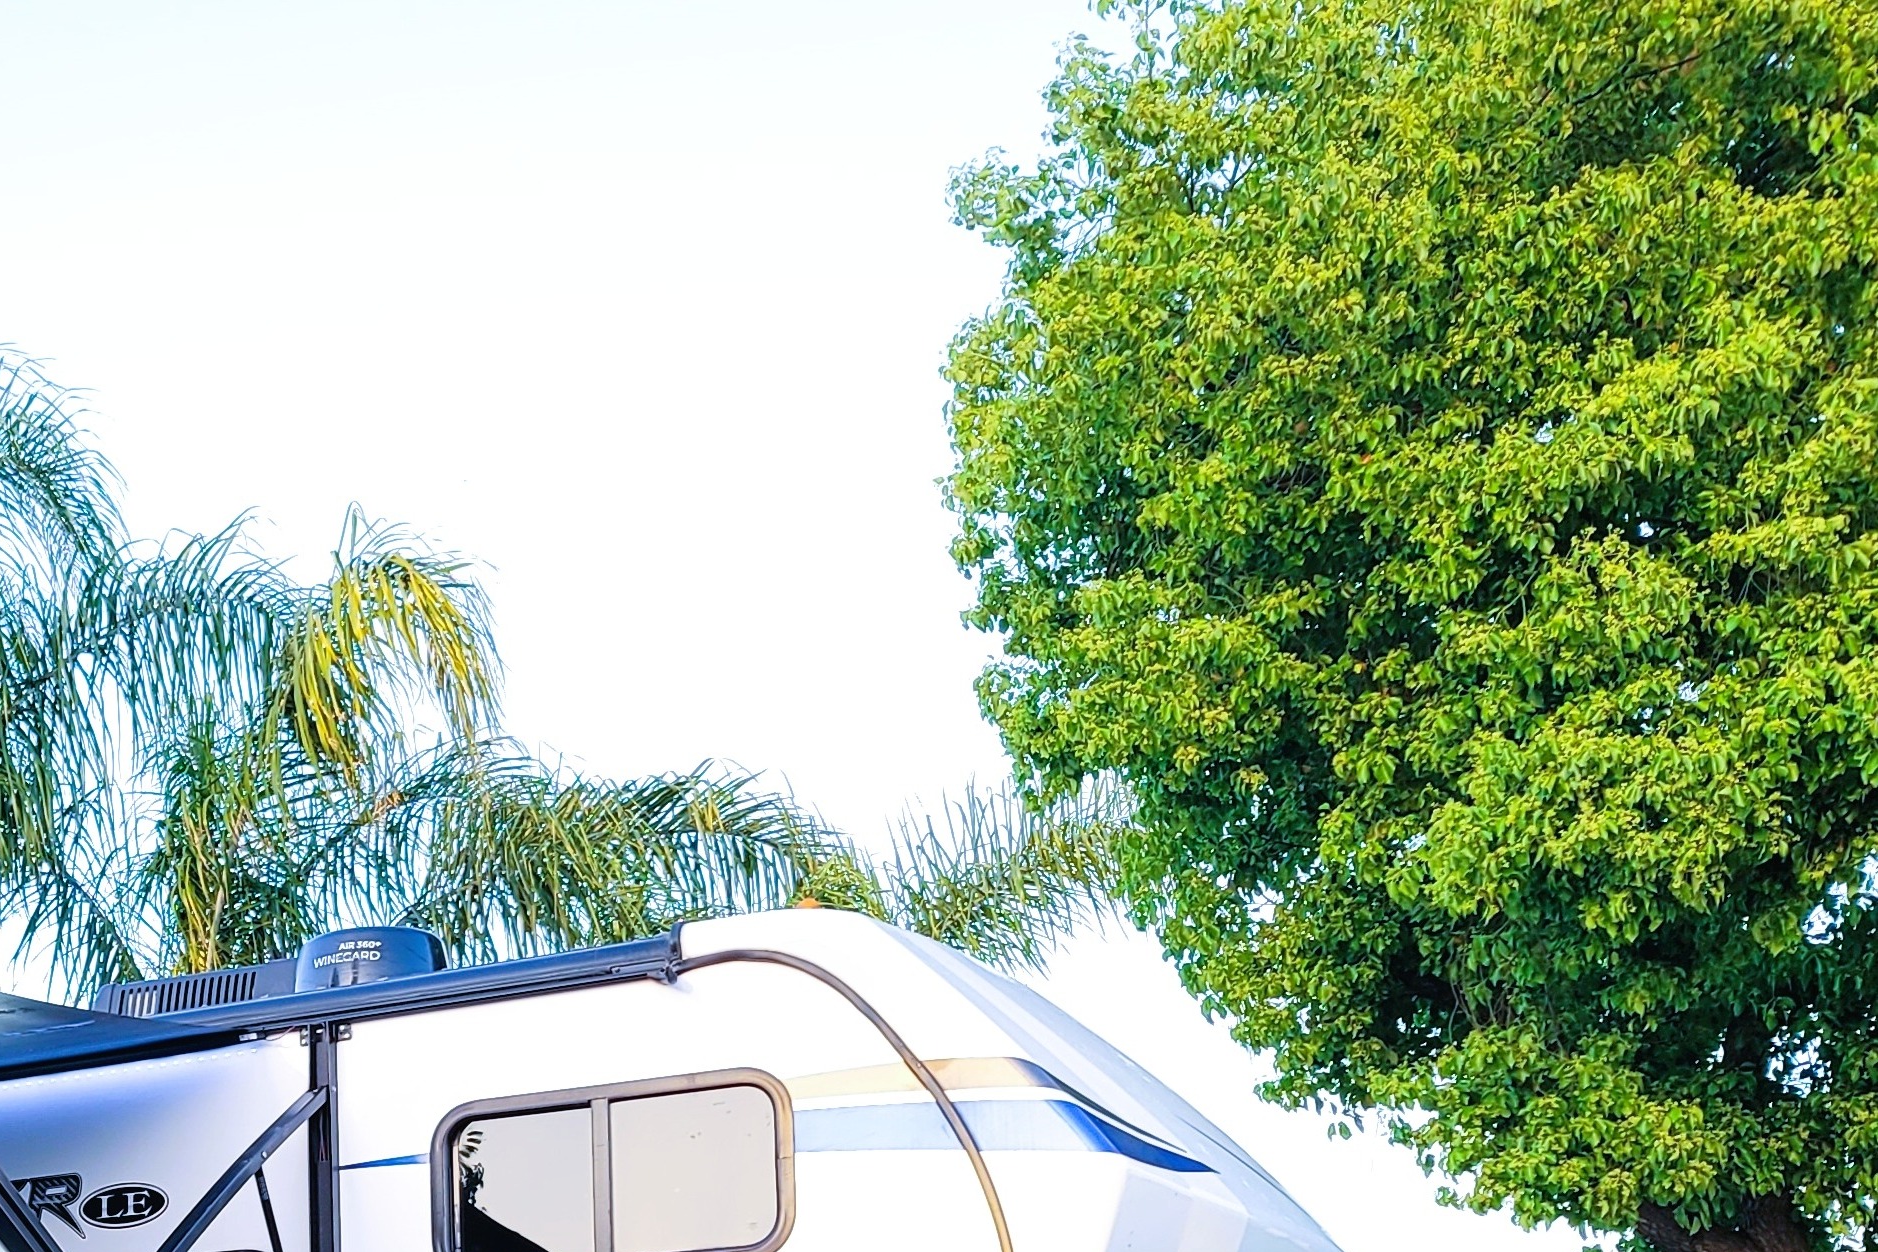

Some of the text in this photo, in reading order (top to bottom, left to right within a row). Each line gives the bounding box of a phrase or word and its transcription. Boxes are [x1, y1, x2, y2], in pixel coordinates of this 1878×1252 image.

[338, 941, 355, 951] AIR
[313, 950, 381, 969] WINEGARD
[96, 1190, 153, 1220] LE
